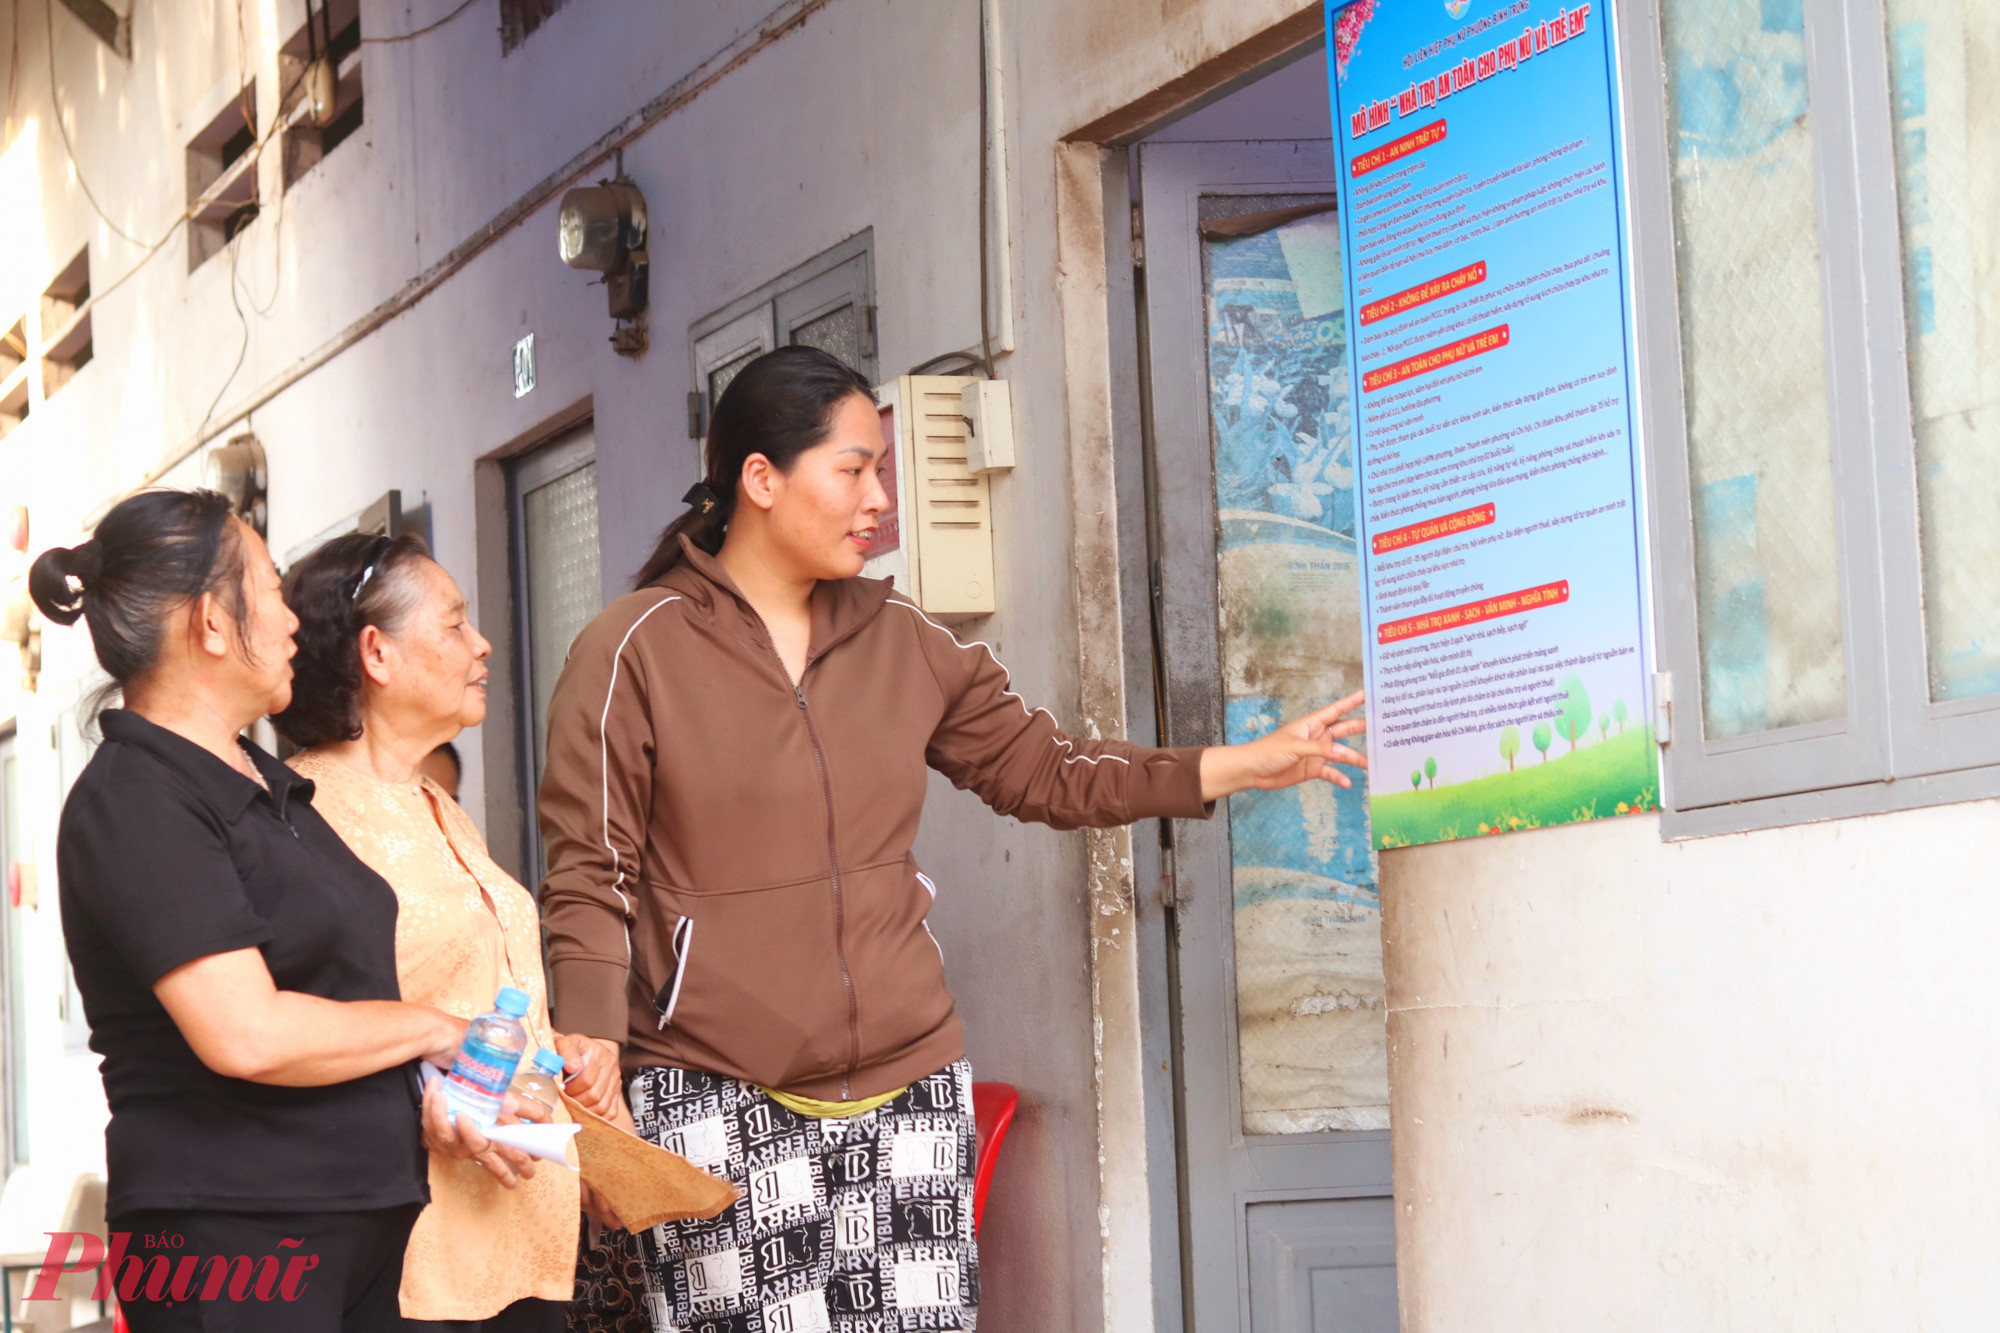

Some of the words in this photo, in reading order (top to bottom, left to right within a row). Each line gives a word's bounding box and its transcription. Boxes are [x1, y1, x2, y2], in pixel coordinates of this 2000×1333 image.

[1415, 45, 1427, 63] LIÊN
[1428, 38, 1441, 58] HIỆP
[1444, 33, 1455, 50] PHỤ
[1457, 26, 1465, 43] NỮ
[1351, 103, 1367, 138] MÔ
[1367, 93, 1389, 130] HÌNH
[1398, 80, 1418, 117] NHÀ
[1418, 76, 1436, 113] TRỌ
[1436, 70, 1450, 99] AN
[1451, 52, 1476, 93] TOÀN
[1477, 47, 1496, 80] CHO
[1497, 38, 1517, 76] PHỤ
[1518, 25, 1533, 61] NỮ
[1534, 17, 1548, 54] VÀ
[1548, 6, 1567, 47] TRẺ
[1357, 155, 1370, 172] TIÊU
[1370, 150, 1380, 166] CHÍ
[1390, 144, 1398, 157] AN
[1399, 137, 1414, 153] NINH
[1415, 128, 1430, 148] TRẬT
[1430, 125, 1439, 141] TỰ
[1366, 304, 1378, 320] TIÊU
[1379, 299, 1389, 315] CHÍ
[1398, 289, 1419, 308] KHÔNG
[1420, 282, 1428, 300] ĐỂ
[1429, 280, 1441, 296] XẢY
[1441, 279, 1449, 292] RA
[1450, 271, 1466, 288] CHÁY
[1467, 264, 1477, 282] NỔ
[1369, 371, 1381, 387] TIÊU
[1382, 367, 1392, 382] CHÍ
[1401, 363, 1410, 375] AN
[1411, 355, 1428, 372] TOÀN
[1428, 353, 1441, 366] CHO
[1442, 348, 1454, 364] PHỤ
[1455, 341, 1466, 357] NỮ
[1467, 339, 1475, 353] VÀ
[1476, 333, 1487, 349] TRẺ
[1488, 332, 1498, 345] EM
[1378, 534, 1391, 549] TIÊU
[1392, 530, 1402, 545] CHÍ
[1411, 528, 1420, 542] TỰ
[1421, 520, 1438, 537] QUẢN
[1439, 518, 1448, 532] VÀ
[1448, 513, 1466, 532] CỘNG
[1466, 507, 1485, 525] ĐỒNG
[1383, 624, 1396, 638] TIÊU
[1397, 621, 1407, 635] CHÍ
[1416, 616, 1428, 630] NHÀ
[1430, 615, 1442, 629] TRỌ
[1443, 610, 1460, 624] XANH
[1464, 606, 1480, 621] SẠCH
[1484, 600, 1497, 614] VĂN
[1499, 597, 1516, 611] MINH
[1520, 588, 1541, 606] NGHĨA
[1542, 585, 1558, 601] TÌNH
